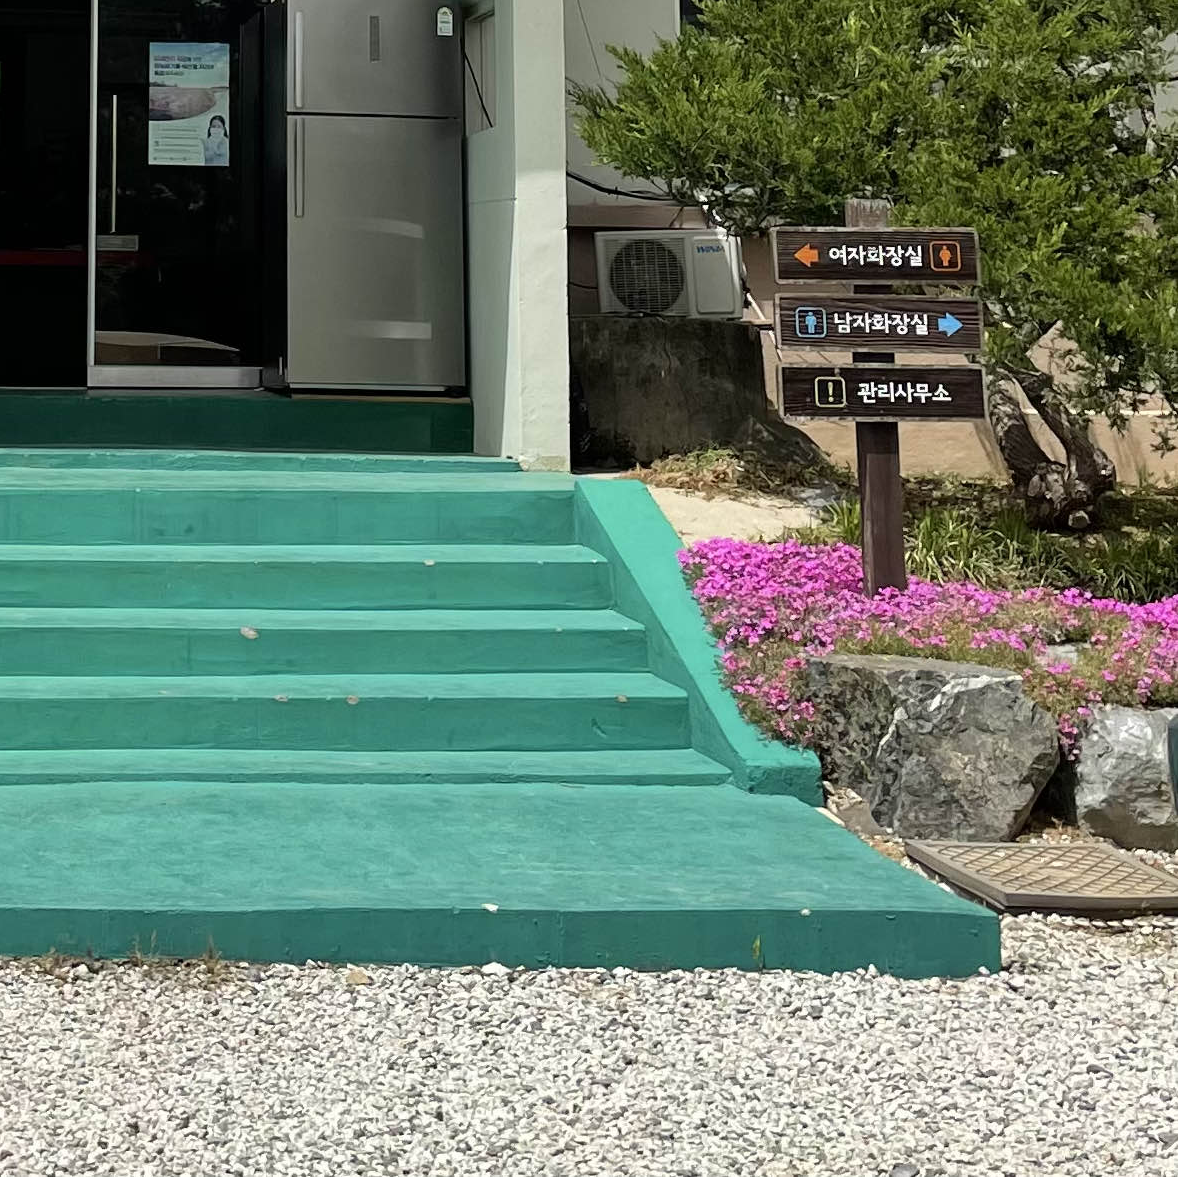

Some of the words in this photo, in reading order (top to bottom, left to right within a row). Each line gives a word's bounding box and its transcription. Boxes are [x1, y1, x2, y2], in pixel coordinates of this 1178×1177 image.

[828, 244, 923, 267] 여자화장실
[833, 312, 929, 336] 남자화장실
[857, 382, 952, 404] 관리사무소
